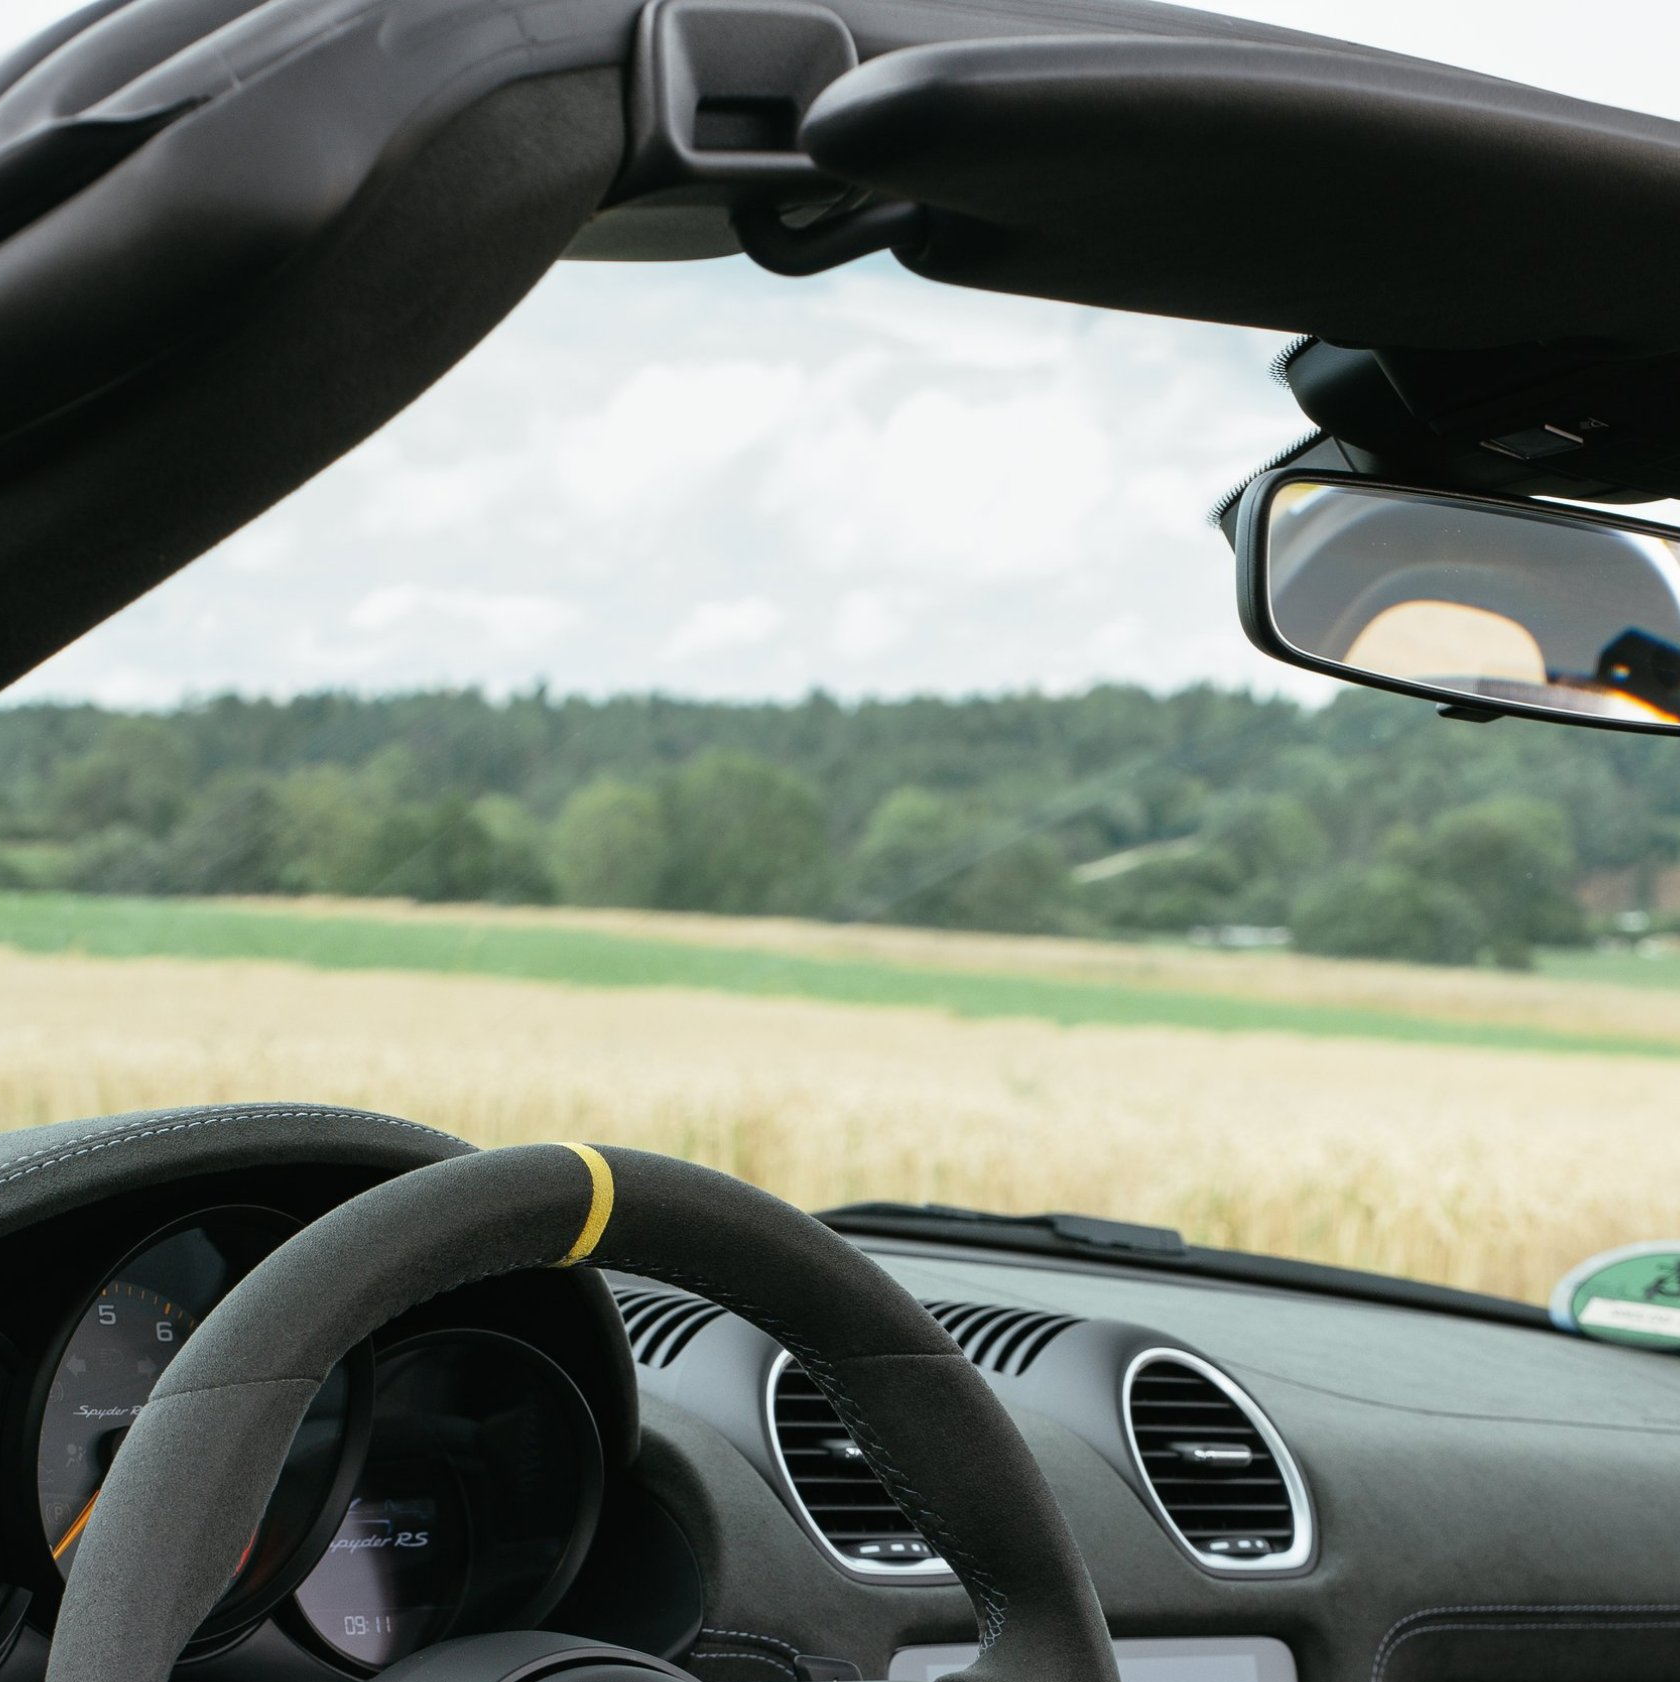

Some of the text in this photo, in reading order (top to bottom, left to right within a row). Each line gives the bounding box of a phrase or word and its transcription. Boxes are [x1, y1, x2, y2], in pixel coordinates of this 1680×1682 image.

[97, 1304, 117, 1325] 5
[155, 1321, 174, 1342] 6
[72, 1404, 144, 1419] Spyder R
[329, 1531, 429, 1553] pyder RS
[343, 1615, 392, 1636] 09:11
